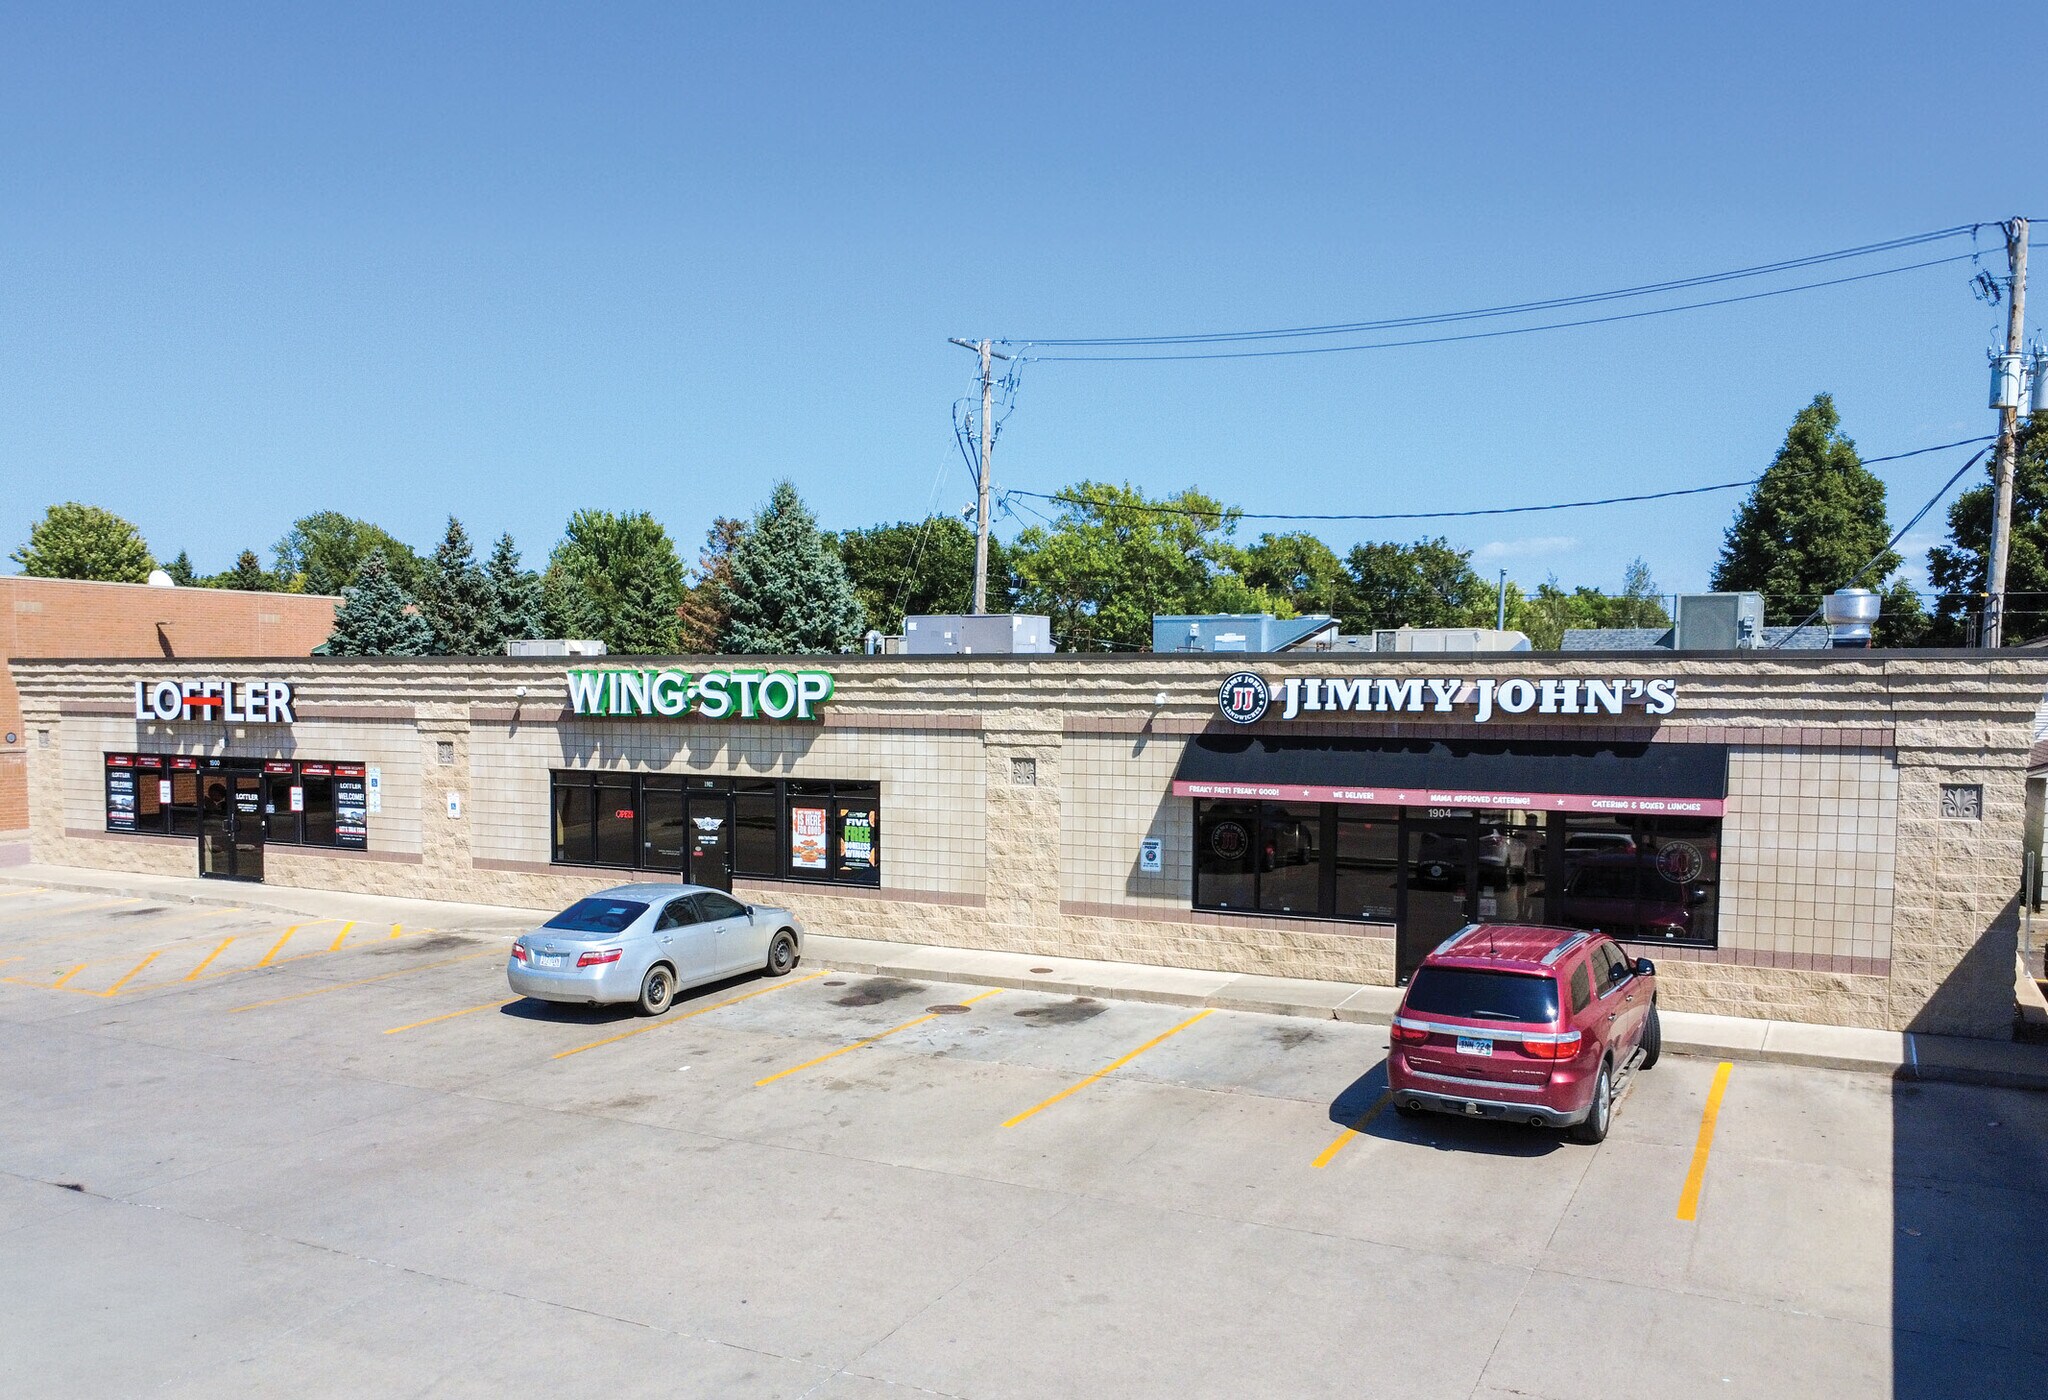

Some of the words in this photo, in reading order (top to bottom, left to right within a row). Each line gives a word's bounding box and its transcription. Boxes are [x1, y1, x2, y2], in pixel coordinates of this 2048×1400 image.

[135, 681, 295, 723] LOFFLER
[1232, 687, 1255, 710] JJ
[1282, 677, 1462, 720] JIMMY
[1474, 677, 1678, 723] JOHN'S
[1189, 785, 1212, 793] FREAKY
[1214, 786, 1232, 794] FAST!
[1233, 787, 1257, 795] FREAKY
[1259, 788, 1280, 796] GOOD!
[1345, 791, 1374, 800] DELIVER!
[338, 793, 364, 801] WELCOME!
[1430, 794, 1452, 803] MAMA
[1454, 795, 1490, 804] APPROVED
[1492, 796, 1531, 805] CATERING!
[1591, 800, 1628, 809] CATERING
[1640, 802, 1664, 810] BOXED
[1667, 803, 1701, 811] LUNCHES
[615, 809, 634, 819] OPEN
[1428, 808, 1452, 818] 1904
[798, 814, 804, 826] IS
[805, 814, 821, 826] HERE
[846, 818, 868, 826] FIVE
[844, 826, 870, 842] FREE
[845, 841, 870, 850] BONELESS
[845, 850, 870, 859] WINGS
